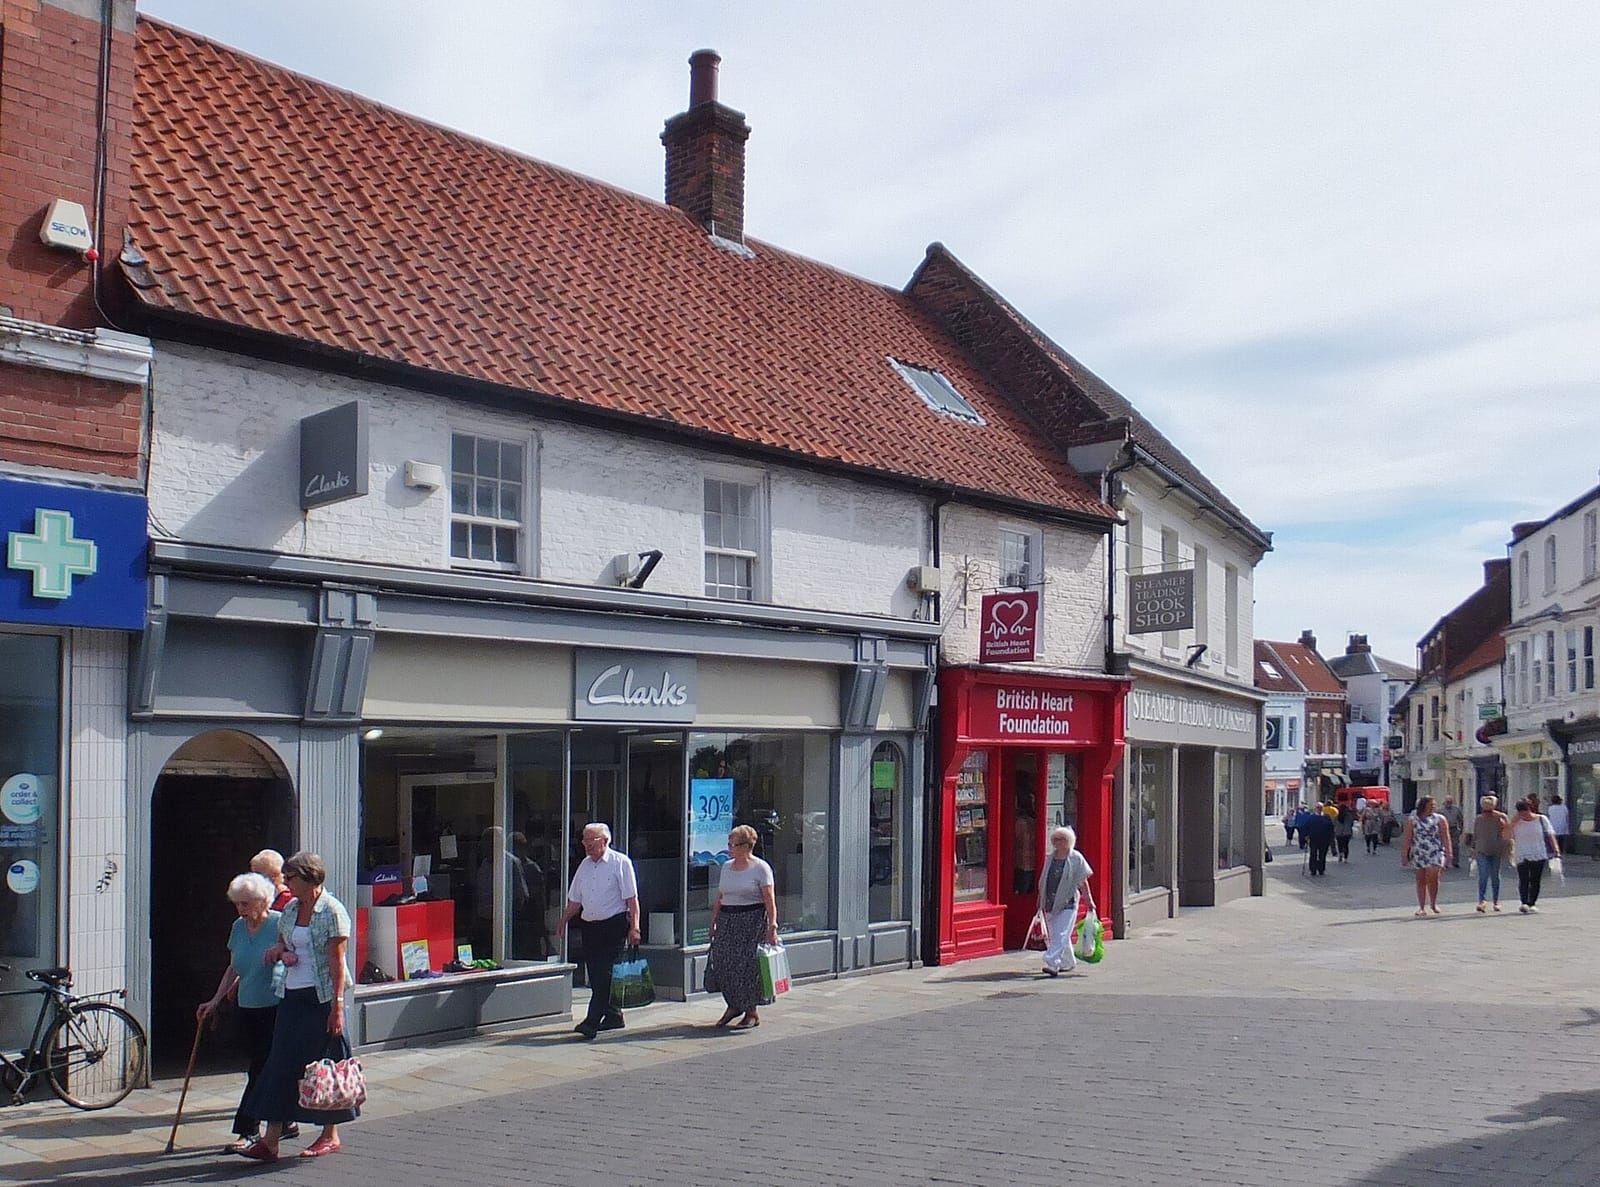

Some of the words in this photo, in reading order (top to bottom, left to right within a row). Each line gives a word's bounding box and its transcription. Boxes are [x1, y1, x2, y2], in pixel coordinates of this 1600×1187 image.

[305, 471, 350, 497] Clarks
[1135, 577, 1186, 591] STEAMER
[1136, 586, 1185, 600] TRADING
[1135, 597, 1185, 614] COOK
[1135, 610, 1186, 627] SHOP
[986, 640, 1008, 648] British
[986, 646, 1030, 656] Foundation
[587, 664, 688, 705] Clarks
[996, 688, 1038, 710] British
[1041, 691, 1073, 712] Heart
[1133, 688, 1176, 723] STEAMER
[1177, 697, 1212, 728] TRADING
[999, 713, 1069, 735] Foundation
[698, 795, 730, 821] 30%
